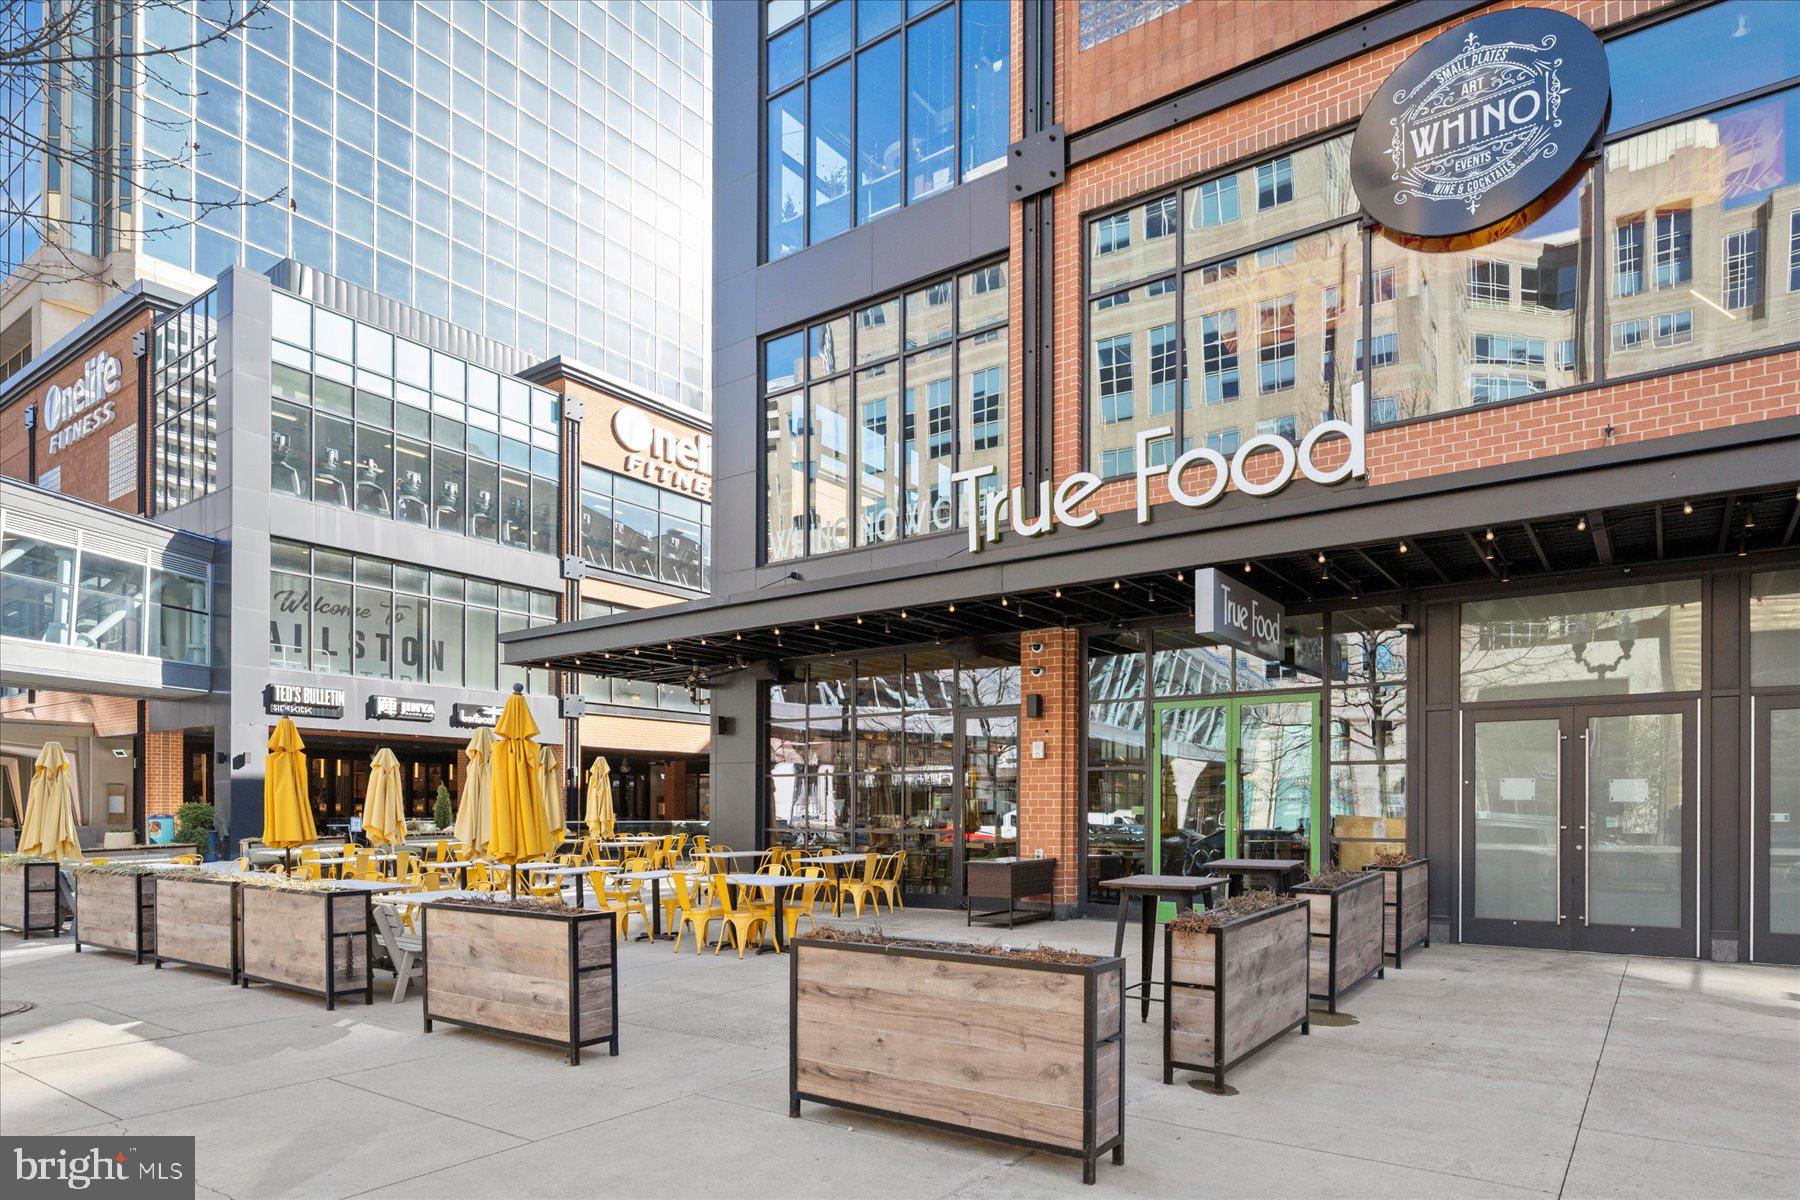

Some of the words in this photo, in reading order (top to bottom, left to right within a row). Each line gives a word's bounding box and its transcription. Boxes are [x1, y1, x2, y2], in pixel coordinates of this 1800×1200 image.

[1436, 59, 1468, 84] SMALL
[1472, 48, 1506, 67] PLATES
[1461, 77, 1483, 96] ART
[1410, 89, 1540, 158] WHINO
[1433, 182, 1456, 195] WINE
[1457, 183, 1465, 194] &
[1466, 161, 1515, 192] COCKTAILS
[1455, 151, 1491, 172] EVENTS
[49, 401, 116, 454] FITNESS
[623, 454, 712, 498] FITNE
[951, 465, 1104, 555] True
[1136, 381, 1367, 525] Food
[273, 589, 373, 619] Welcome
[1221, 583, 1249, 630] True
[1252, 600, 1280, 645] Food
[272, 704, 313, 714] SIDEKICK
[274, 684, 301, 703] TED'S
[303, 687, 345, 706] BULLETIN
[400, 701, 435, 714] JINYA
